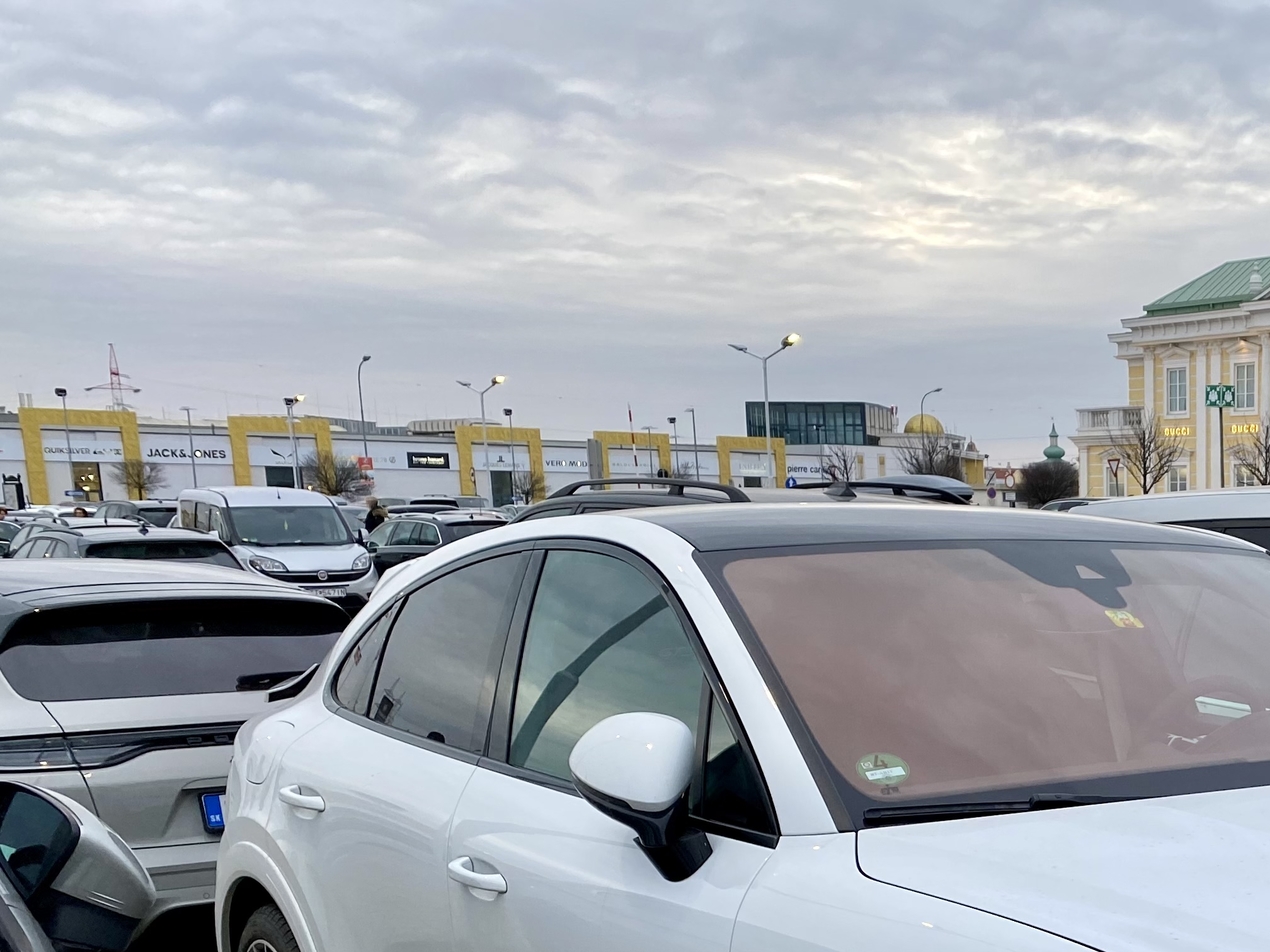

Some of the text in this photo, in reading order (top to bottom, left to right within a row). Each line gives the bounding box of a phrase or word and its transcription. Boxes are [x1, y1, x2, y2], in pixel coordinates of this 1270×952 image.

[1164, 427, 1190, 436] GUCCI
[1231, 424, 1259, 434] GUCCI
[787, 464, 808, 475] pierre
[210, 814, 221, 822] SK
